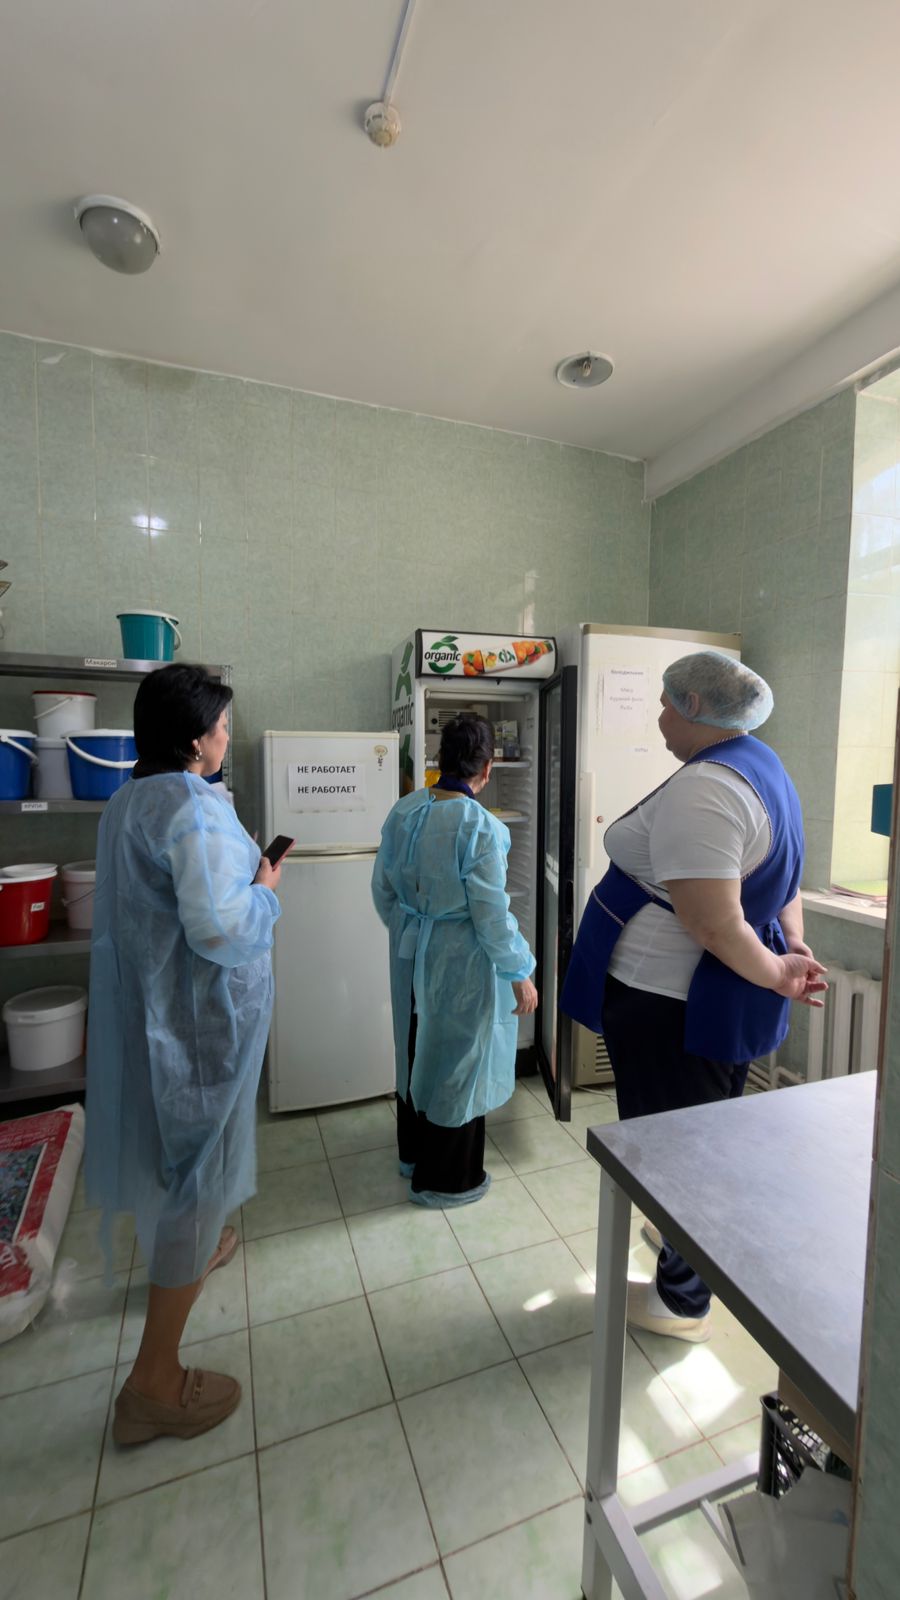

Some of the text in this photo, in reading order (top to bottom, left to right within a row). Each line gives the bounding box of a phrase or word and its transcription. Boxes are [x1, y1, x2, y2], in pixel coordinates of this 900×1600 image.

[424, 650, 461, 662] organic
[297, 765, 356, 774] НЕ РАБОТАЕТ
[297, 785, 357, 794] НЕ РАБОТАЕТ
